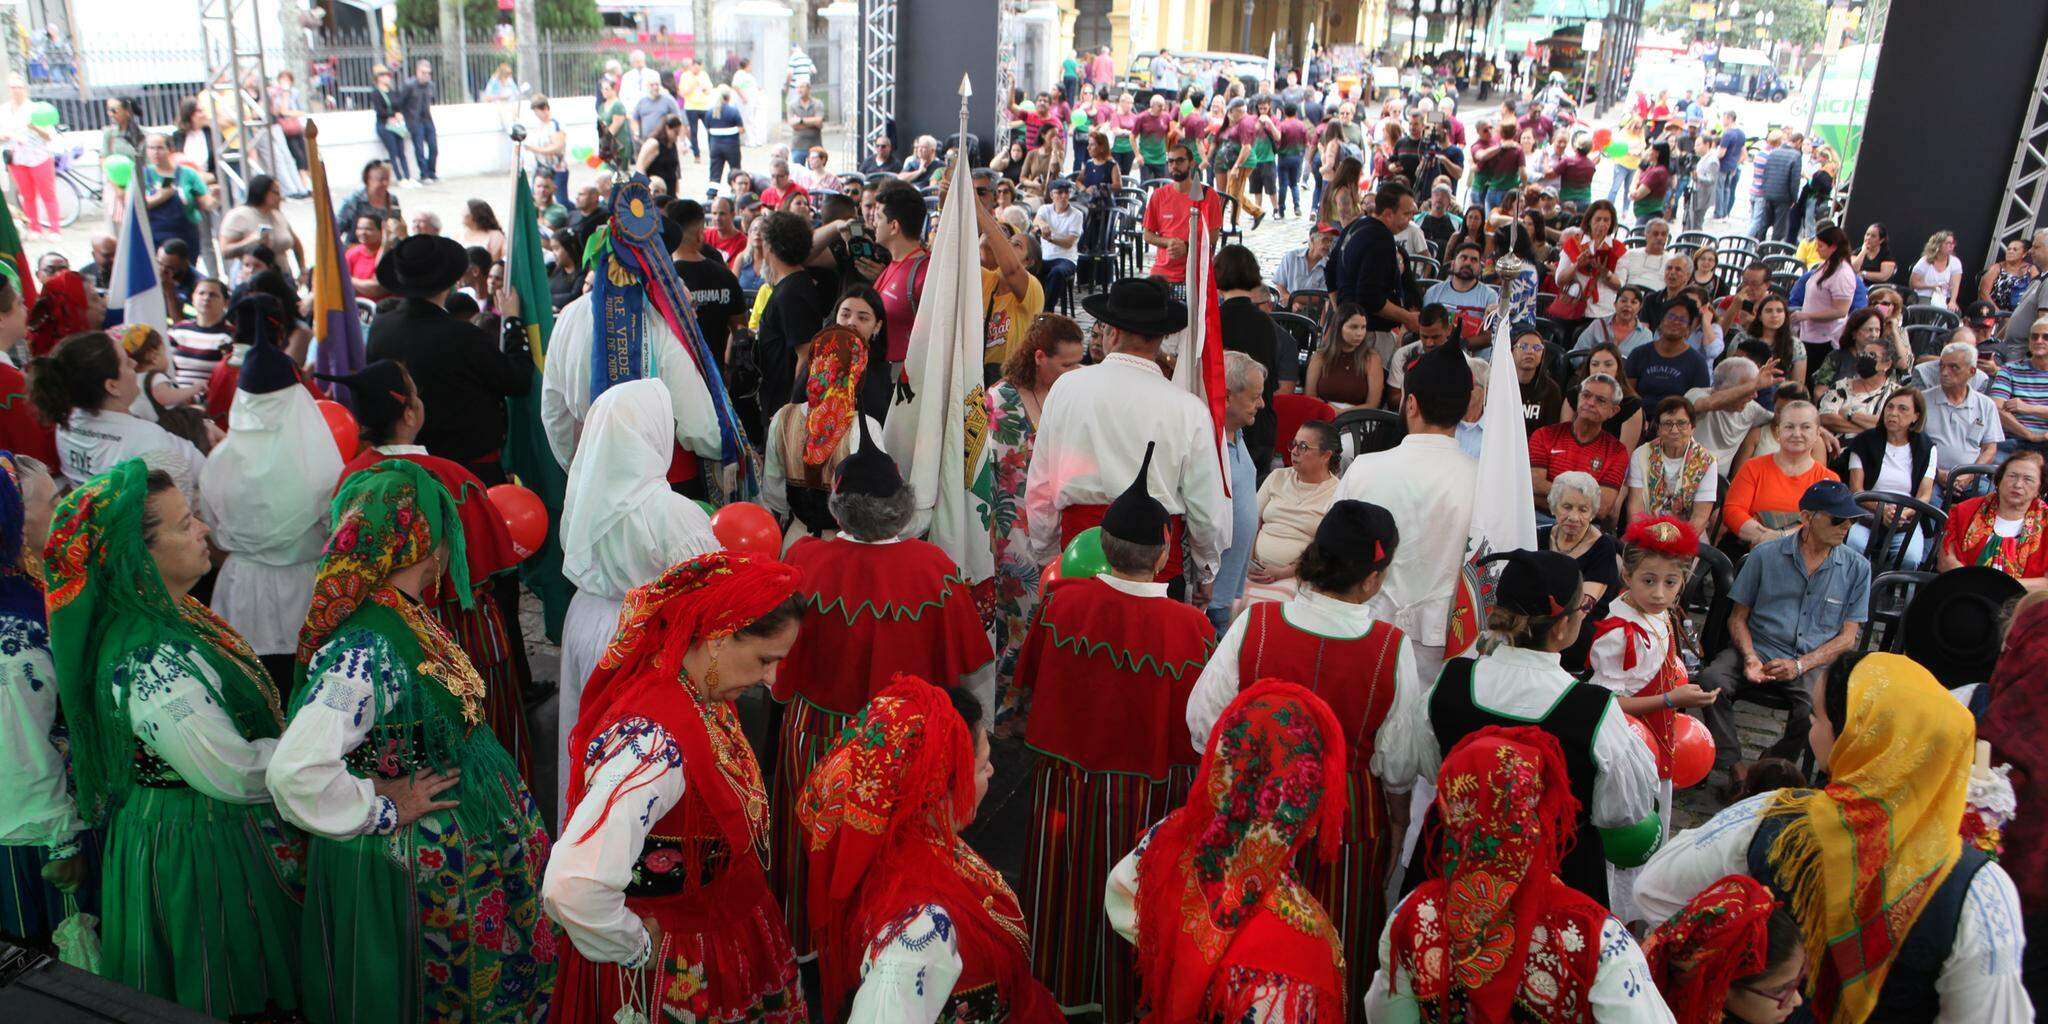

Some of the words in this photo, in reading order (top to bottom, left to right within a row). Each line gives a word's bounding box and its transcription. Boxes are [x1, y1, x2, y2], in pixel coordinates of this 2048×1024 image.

[607, 337, 617, 351] DE
[616, 326, 630, 376] VERDE
[608, 354, 619, 382] OURO
[1646, 365, 1681, 377] HEALTH
